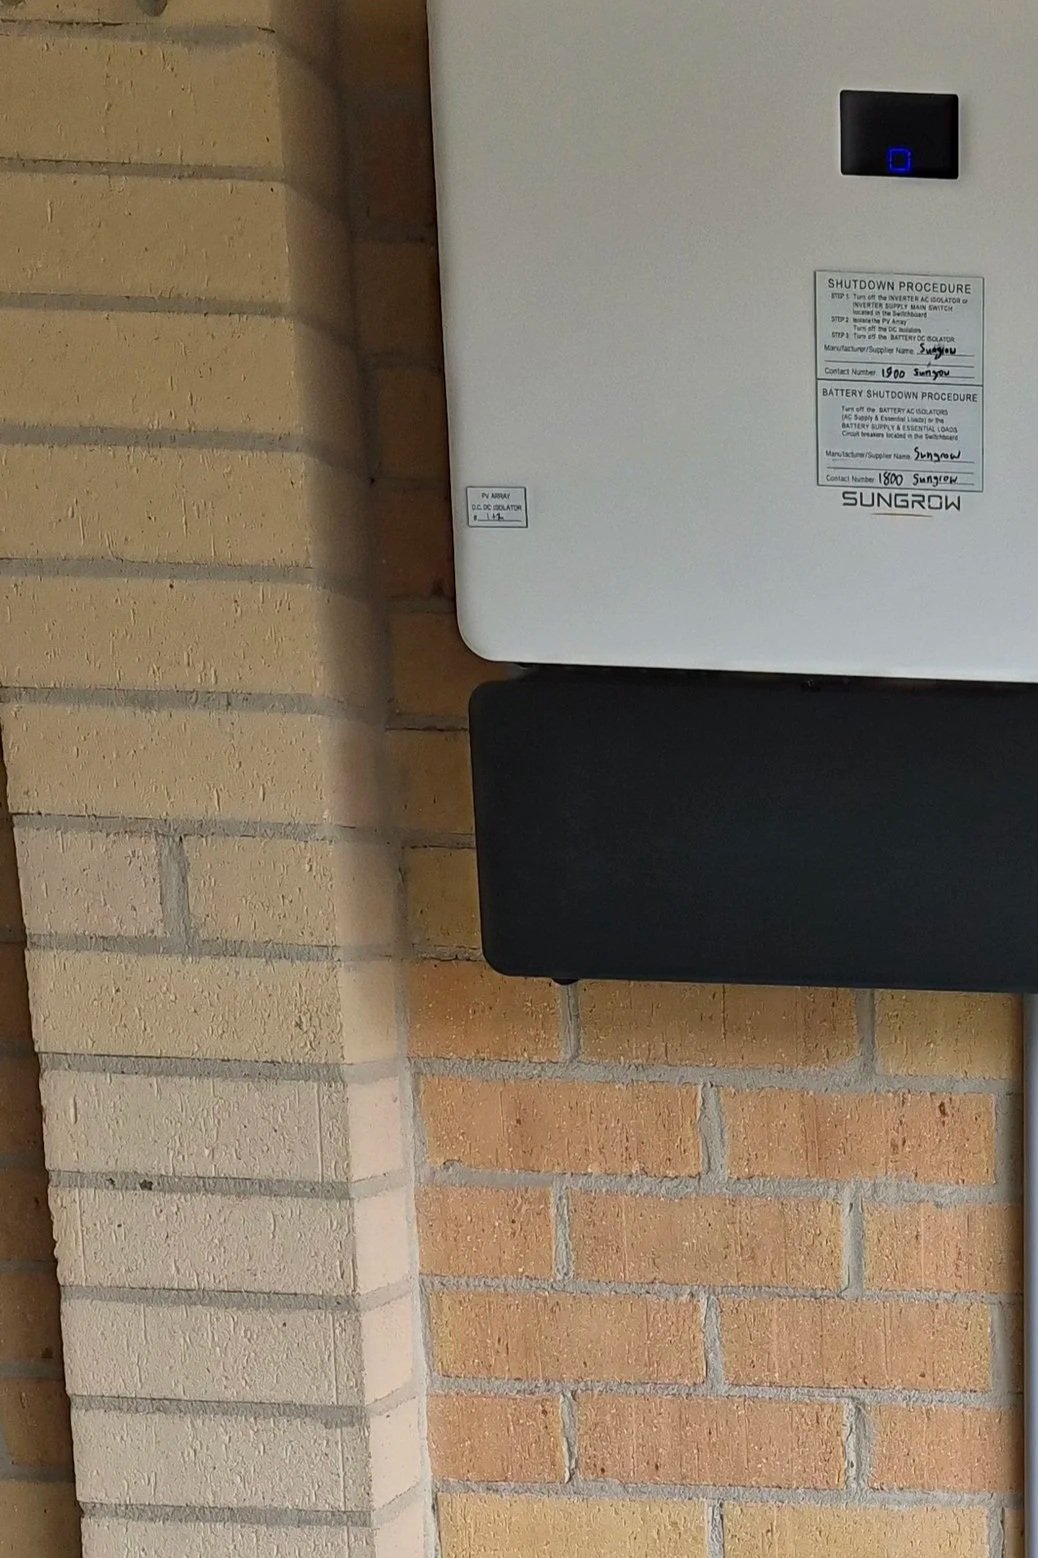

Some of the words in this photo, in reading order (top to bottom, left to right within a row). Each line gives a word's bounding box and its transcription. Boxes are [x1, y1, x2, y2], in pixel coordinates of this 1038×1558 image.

[828, 278, 895, 290] SHUTDOWN
[899, 281, 972, 294] PROCEDURE
[892, 310, 928, 318] Switchboard
[824, 344, 894, 355] Manufacturer/Supplier
[824, 367, 849, 376] Contact
[822, 388, 864, 398] BATTERY
[866, 389, 918, 400] SHUTDOWN
[922, 392, 978, 402] PROCEDURE
[842, 422, 869, 430] BATTERY
[872, 423, 895, 432] SUPPLY
[842, 430, 860, 438] Circuit
[861, 430, 884, 438] breakers
[826, 450, 892, 460] Manufacturer/Supplier
[914, 446, 961, 462] Sungrow
[826, 474, 850, 482] Contact
[852, 475, 874, 483] Number
[878, 472, 904, 486] 1800
[912, 474, 958, 487] Sungrow
[842, 491, 961, 512] SUNGROW
